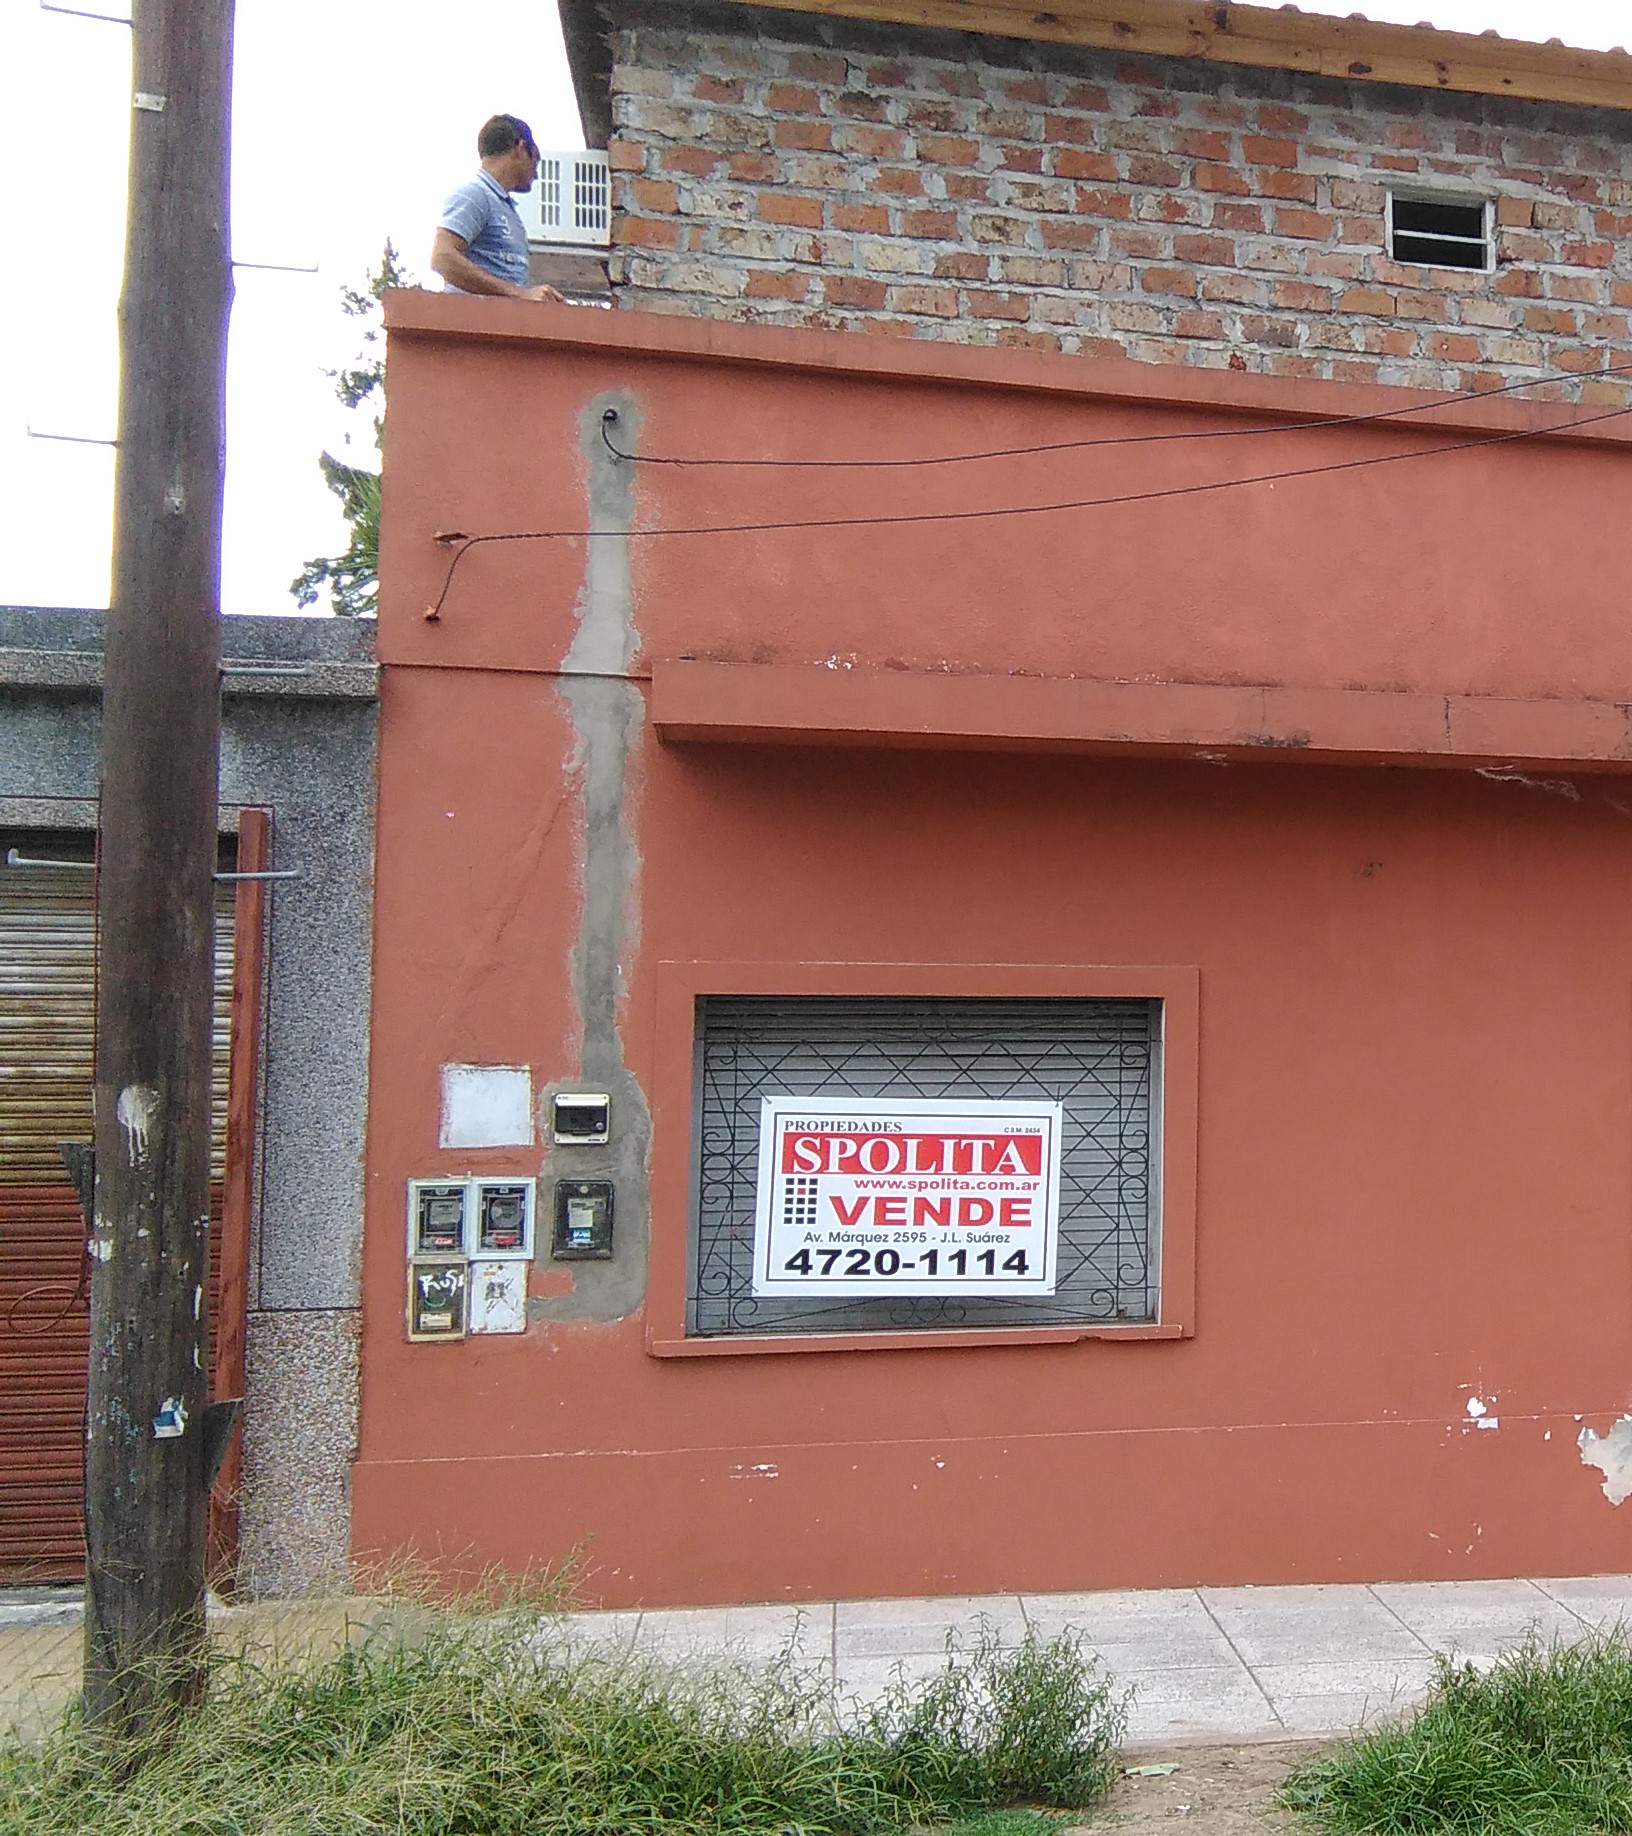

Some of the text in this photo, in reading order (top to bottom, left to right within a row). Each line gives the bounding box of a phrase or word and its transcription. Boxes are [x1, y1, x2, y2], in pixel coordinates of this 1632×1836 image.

[784, 1120, 903, 1133] PROPIEDADES
[793, 1136, 1030, 1175] SPOLITA
[854, 1178, 1040, 1191] www.spolita.com.ar
[828, 1195, 1032, 1227] VENDE
[803, 1231, 824, 1243] Av.
[828, 1230, 889, 1246] Márquez
[893, 1232, 927, 1243] 2595
[940, 1232, 962, 1244] J.L.
[966, 1231, 1011, 1244] Suárez
[783, 1248, 1030, 1276] 4720-1114
